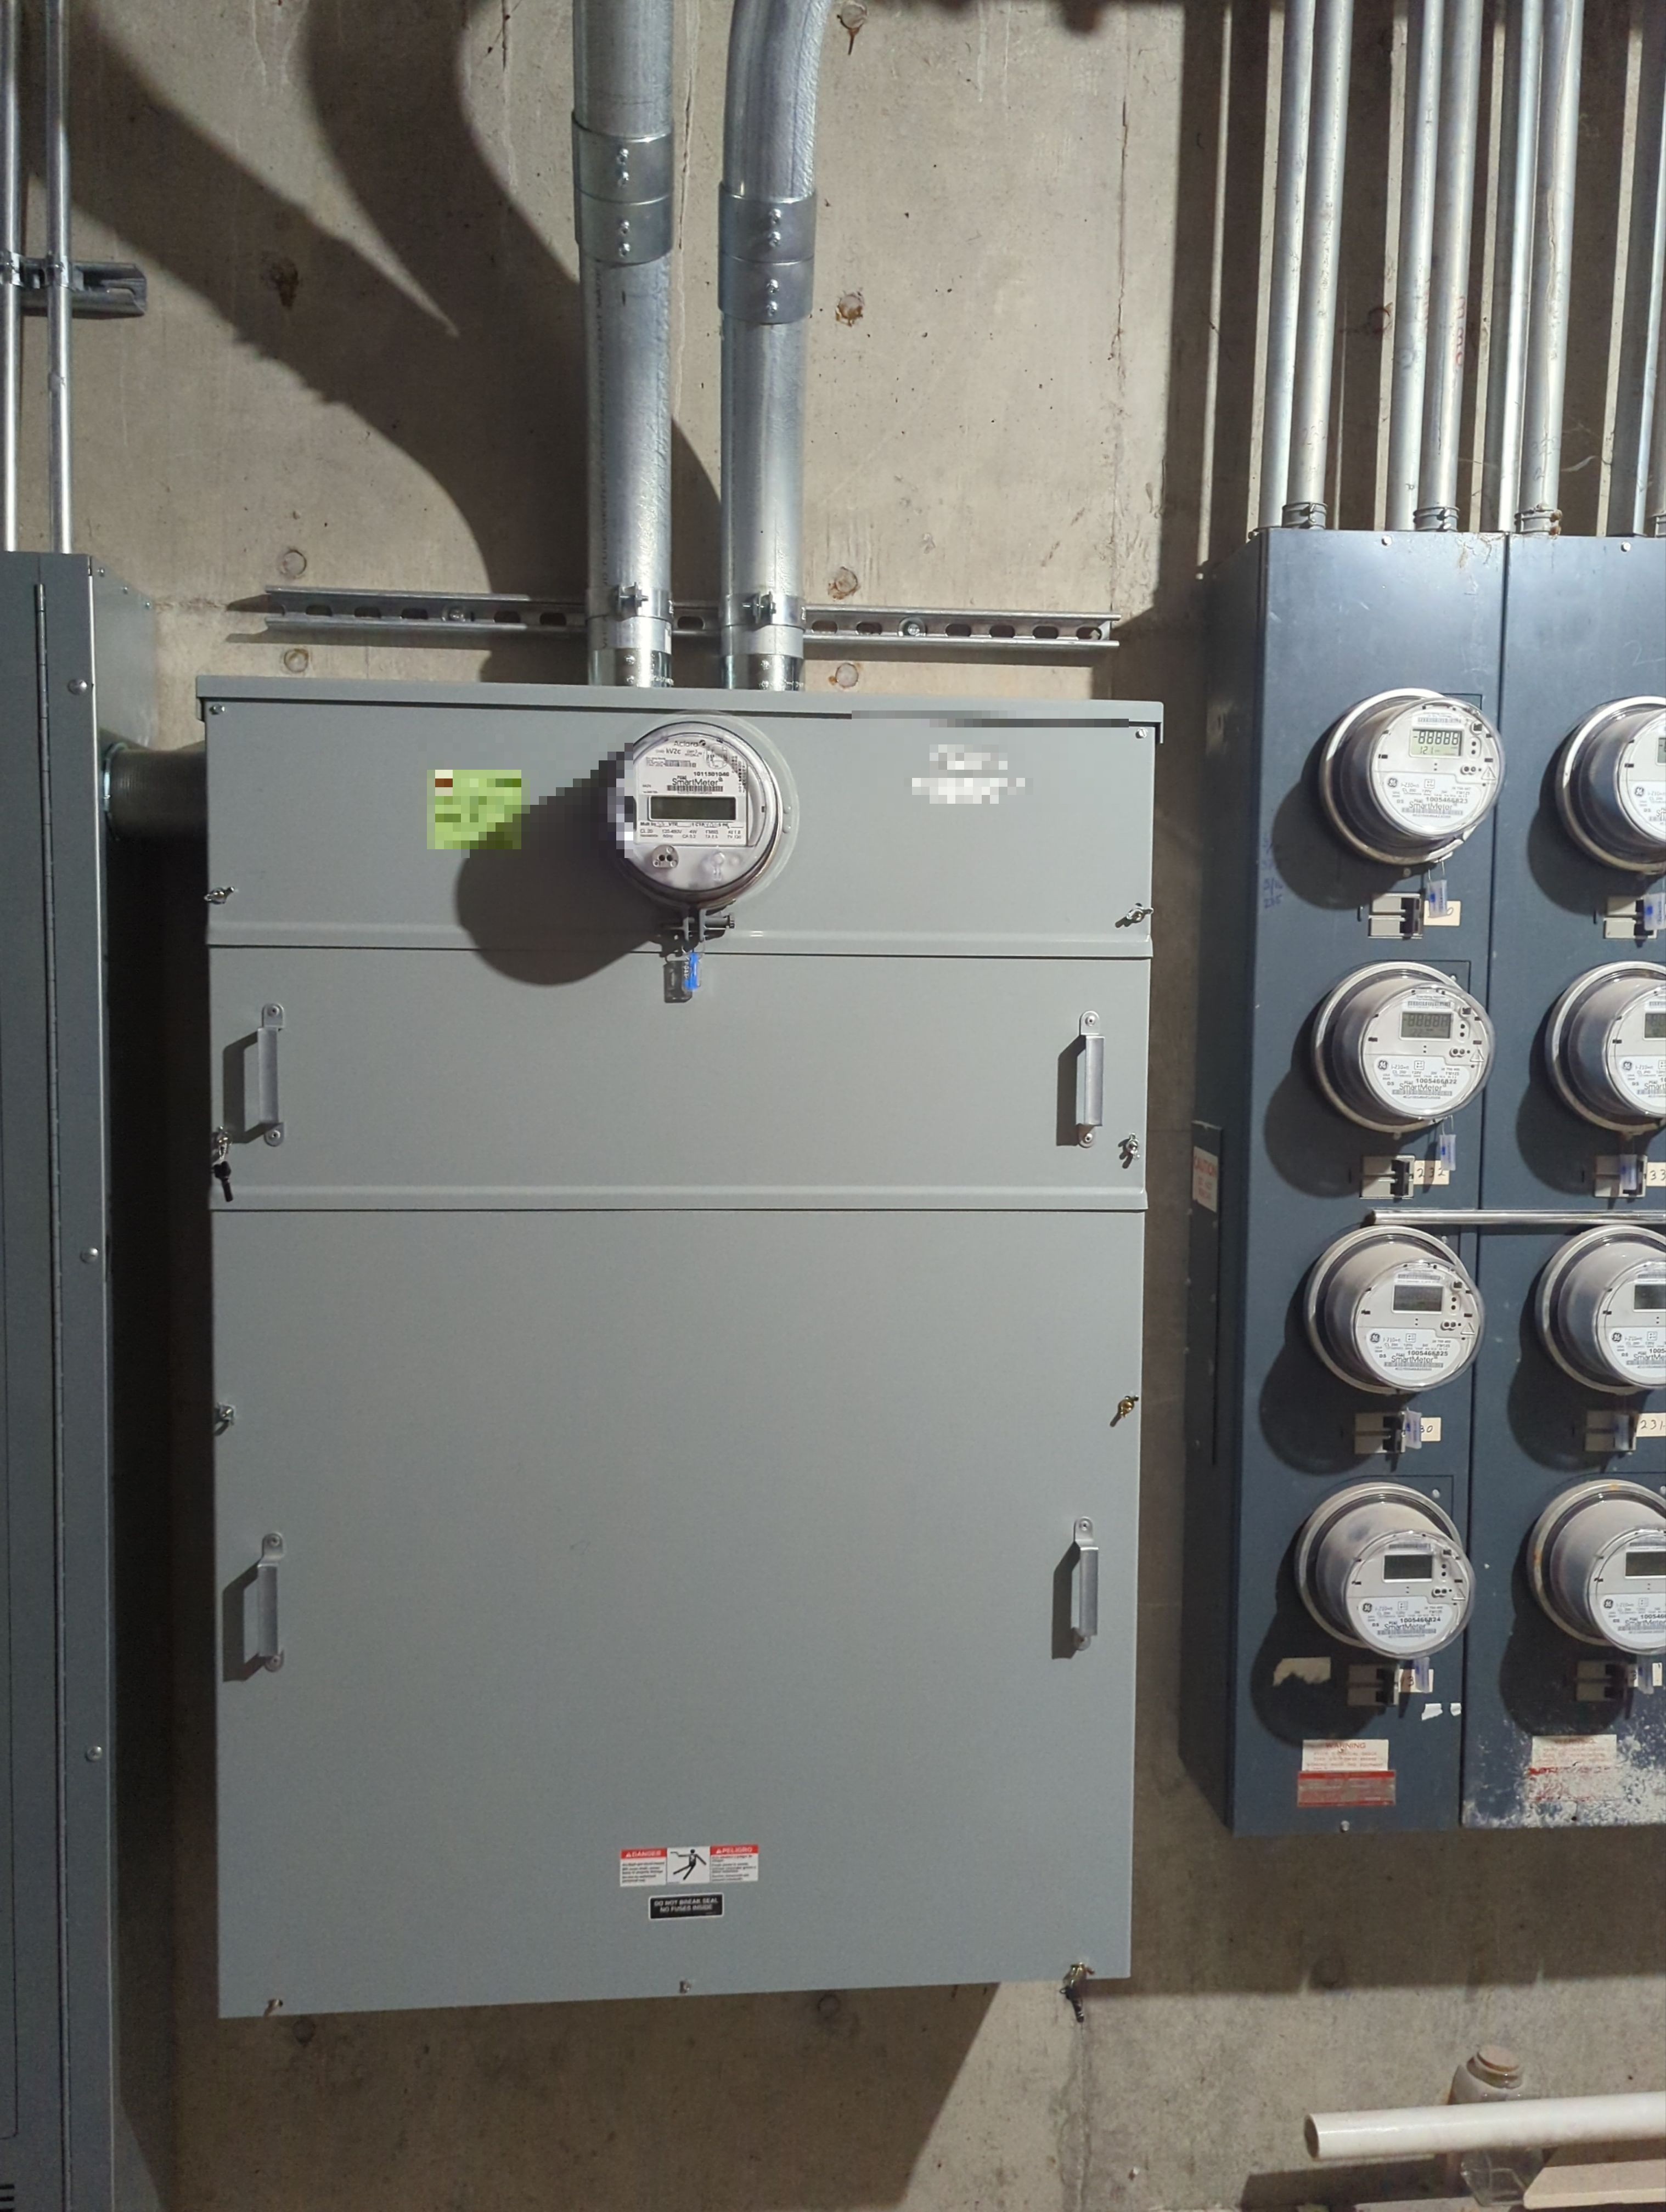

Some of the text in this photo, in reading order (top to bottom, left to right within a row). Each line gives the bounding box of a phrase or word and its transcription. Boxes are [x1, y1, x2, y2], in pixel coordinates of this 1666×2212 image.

[1409, 800, 1453, 811] SmartMeter
[1399, 1083, 1442, 1092] SmartMeter
[1417, 1167, 1445, 1179] 232
[1391, 1355, 1434, 1363] SmartMeter
